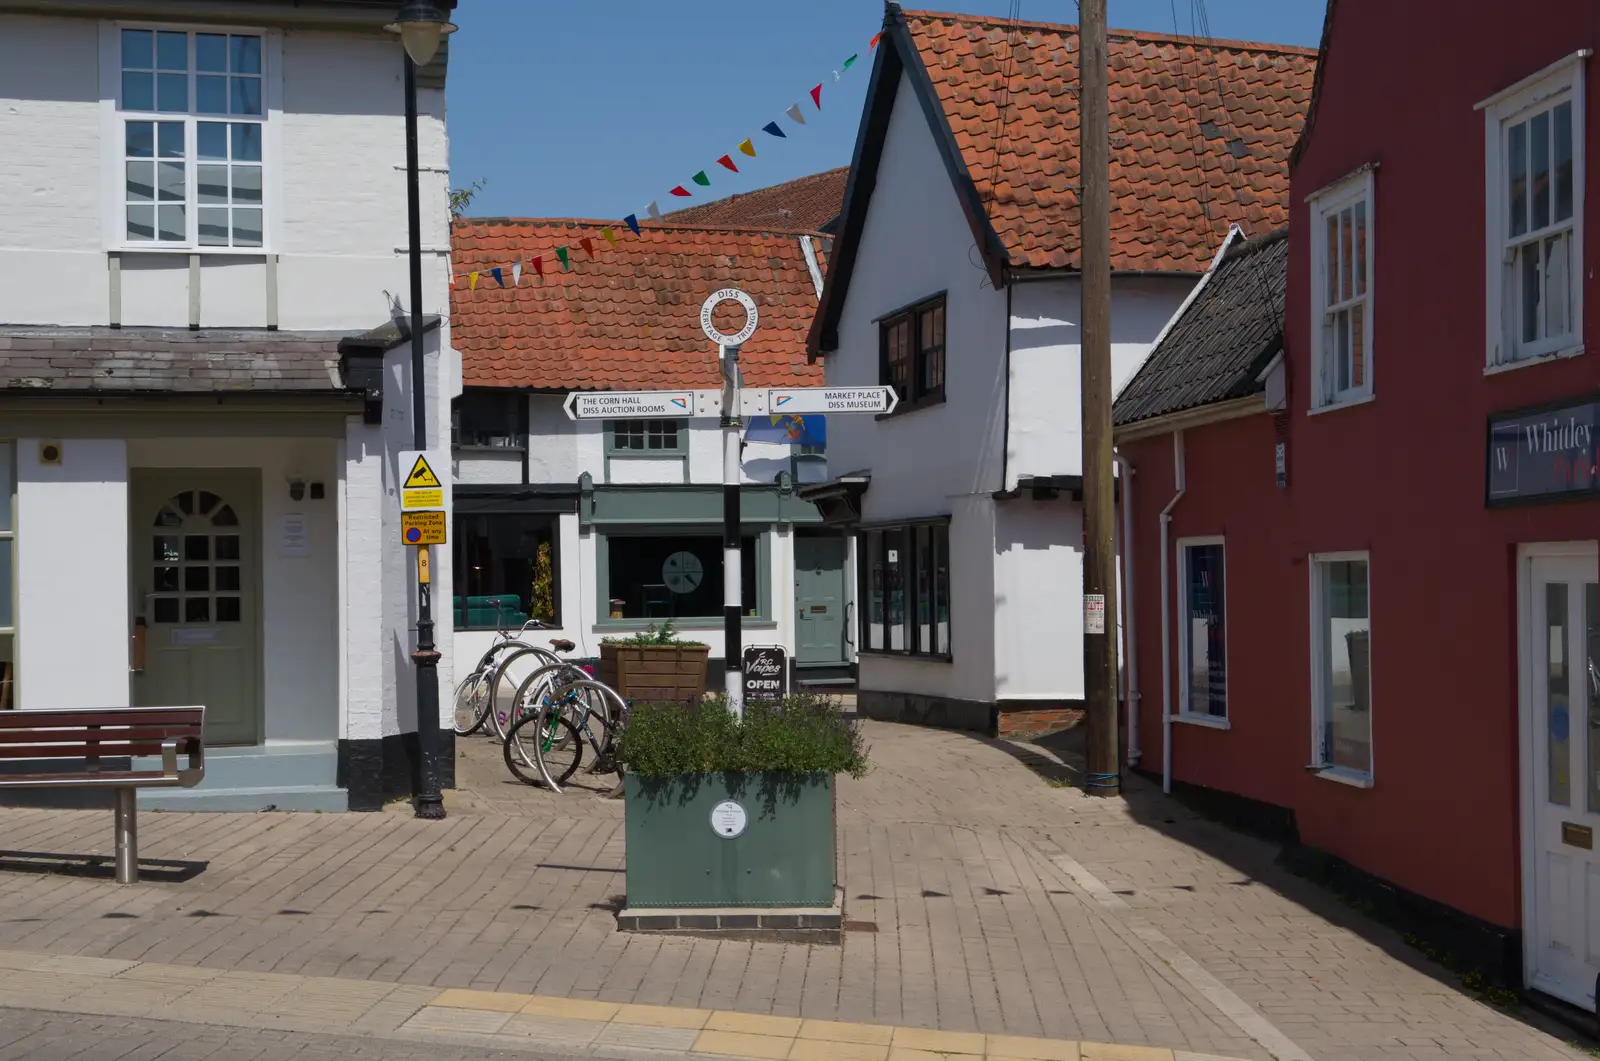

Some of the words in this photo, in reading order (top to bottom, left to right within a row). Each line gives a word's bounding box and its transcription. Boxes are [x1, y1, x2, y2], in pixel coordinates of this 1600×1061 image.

[717, 289, 740, 299] DISS
[702, 307, 723, 342] HERITAGE
[737, 306, 757, 341] TRIANGLE
[824, 392, 856, 400] MARKET
[858, 391, 881, 399] PLACE
[582, 398, 597, 406] THE
[599, 396, 621, 405] CORN
[622, 396, 641, 405] HALL
[828, 401, 845, 409] DISS
[846, 400, 881, 409] MUSEUM
[583, 406, 600, 415] DISS
[601, 406, 636, 414] AUCTION
[636, 405, 666, 413] ROOMS
[1525, 416, 1594, 455] Whittley
[745, 658, 781, 674] Vapes
[746, 680, 780, 690] OPEN
